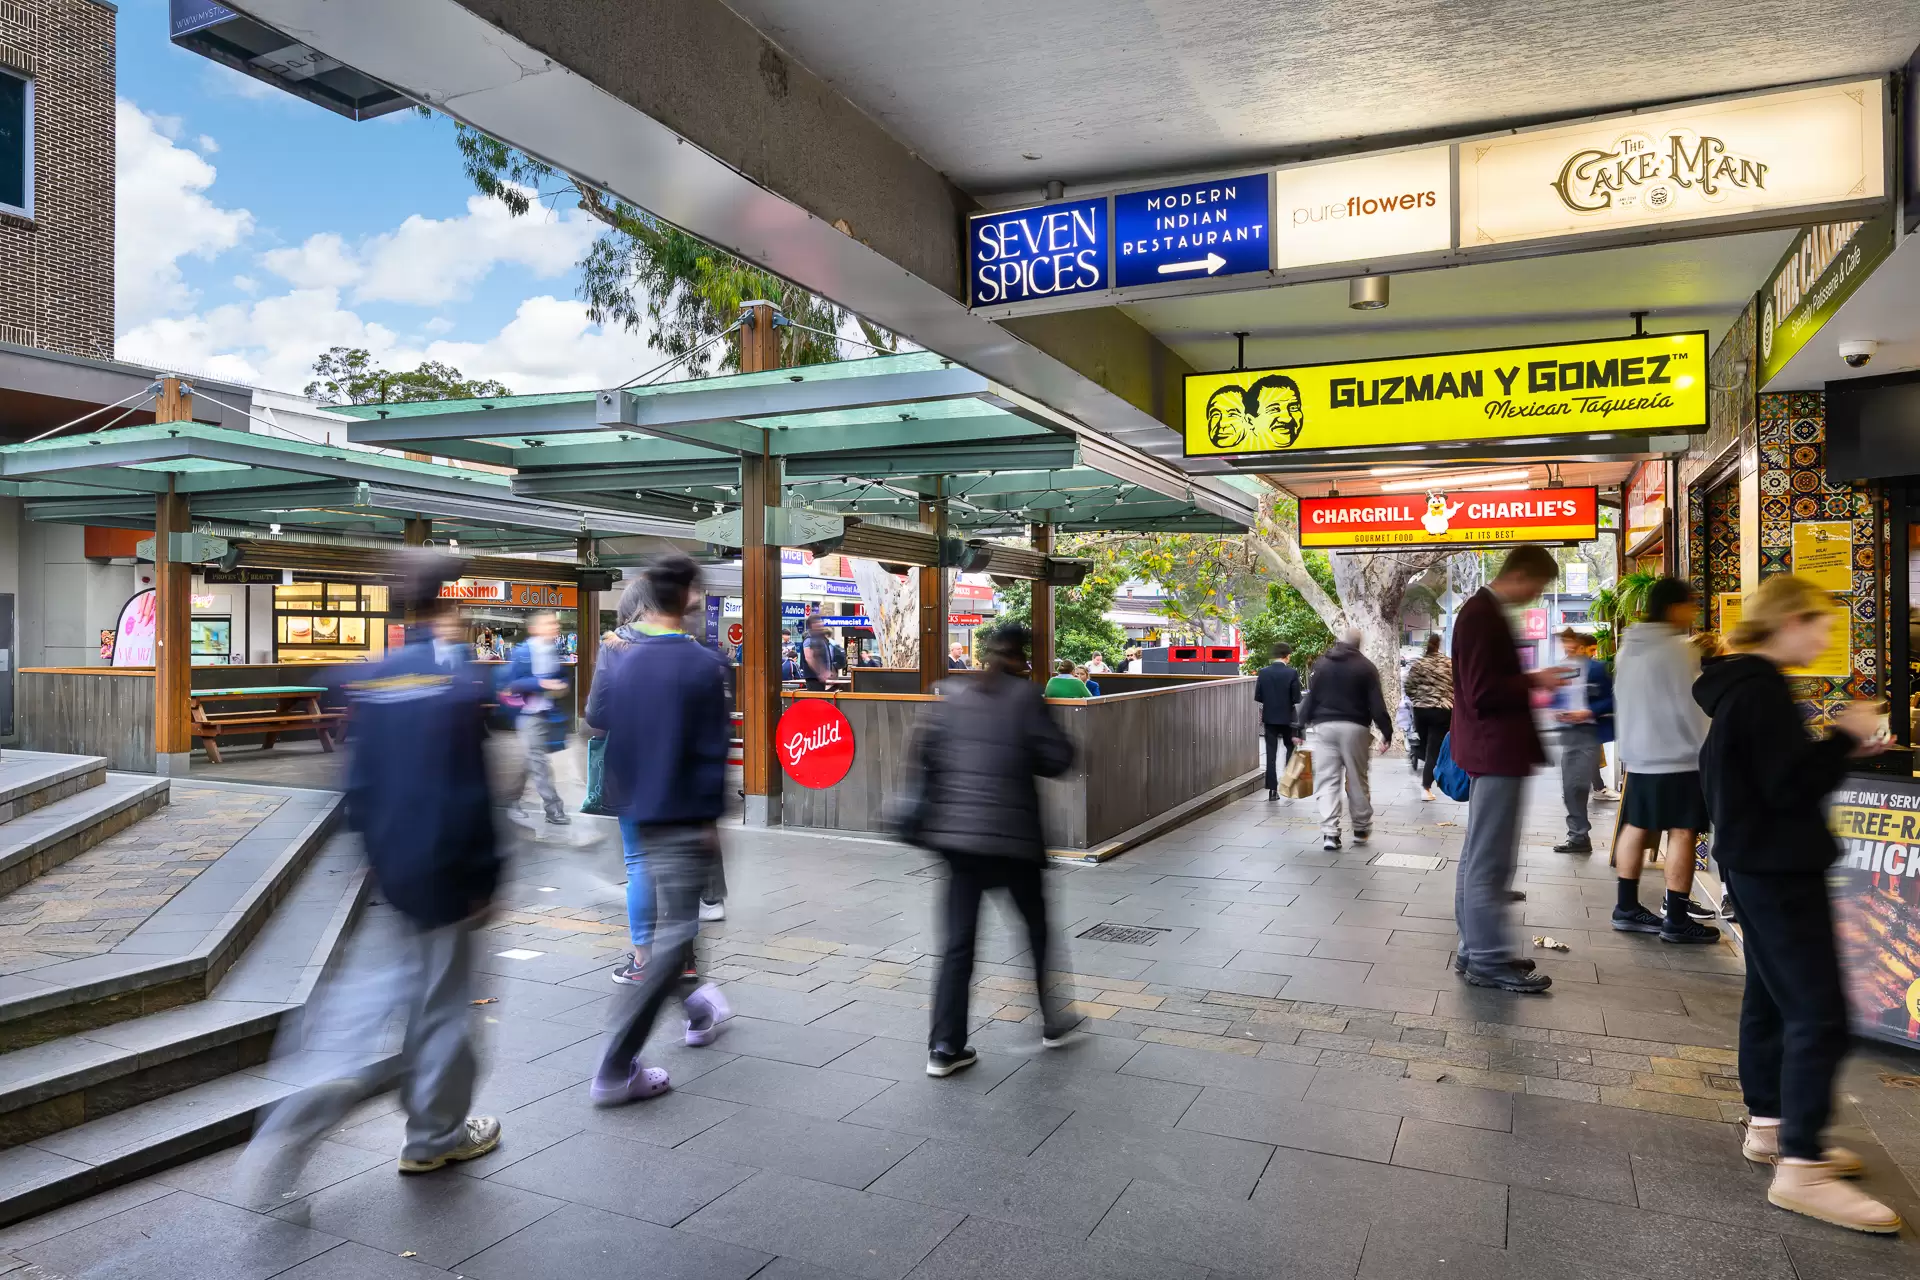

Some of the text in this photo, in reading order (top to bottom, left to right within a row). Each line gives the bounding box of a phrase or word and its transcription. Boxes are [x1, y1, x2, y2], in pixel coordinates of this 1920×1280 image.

[1621, 139, 1644, 155] THE
[1550, 135, 1768, 212] CAKE MAN
[1147, 186, 1237, 212] MODERN
[1293, 190, 1437, 229] pureflowers
[1156, 208, 1228, 231] INDIAN
[977, 207, 1096, 262] SEVEN
[1123, 224, 1264, 256] RESTAURANT
[977, 249, 1100, 302] SPICES
[1773, 252, 1800, 329] THE
[1791, 303, 1812, 340] Specialty
[1812, 272, 1840, 315] Patisserie
[1839, 262, 1845, 284] &
[1845, 244, 1861, 276] Cafe
[1330, 369, 1484, 409] GUZMAN
[1494, 366, 1521, 396] Y
[1527, 353, 1671, 394] GOMEZ
[1484, 400, 1572, 420] Mexican
[1312, 499, 1577, 525] CHARGRILL CHARLIE'S
[1354, 530, 1515, 543] GOURMET FOOD AT ITS BEST
[520, 587, 563, 605] dollar
[827, 584, 853, 593] Pharmacist
[785, 605, 805, 614] Advice
[783, 719, 842, 766] Grill'd
[1859, 792, 1888, 806] ONLY
